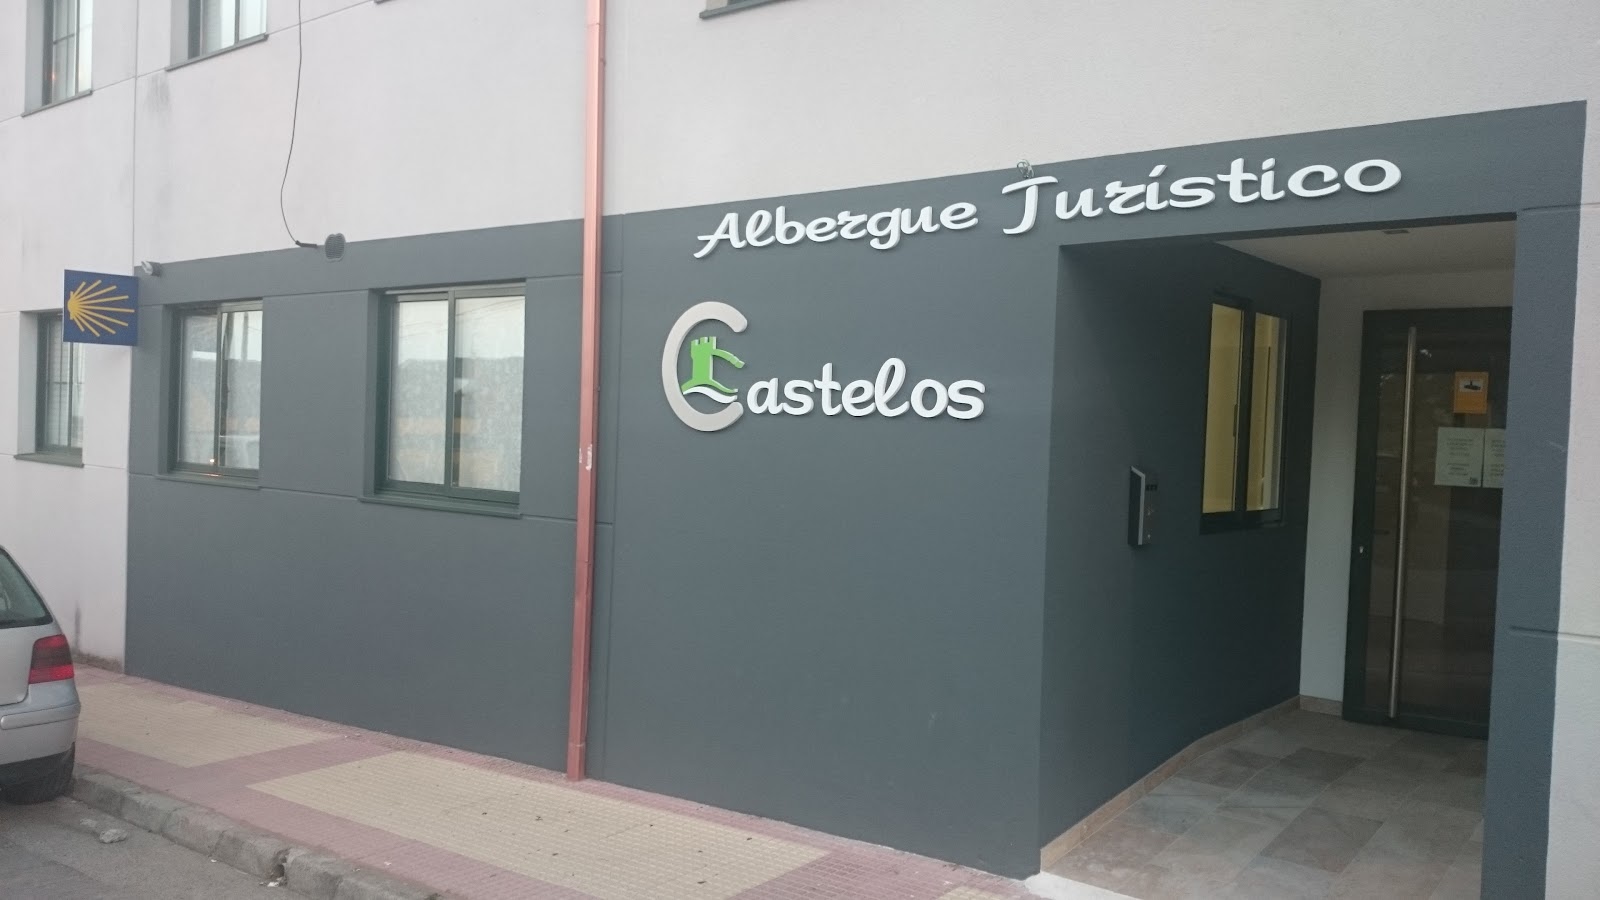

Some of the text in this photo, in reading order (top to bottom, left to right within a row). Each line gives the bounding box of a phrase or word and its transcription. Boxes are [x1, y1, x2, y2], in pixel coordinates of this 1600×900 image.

[694, 157, 1402, 258] Albergue Turístico
[661, 301, 986, 433] Castelos
